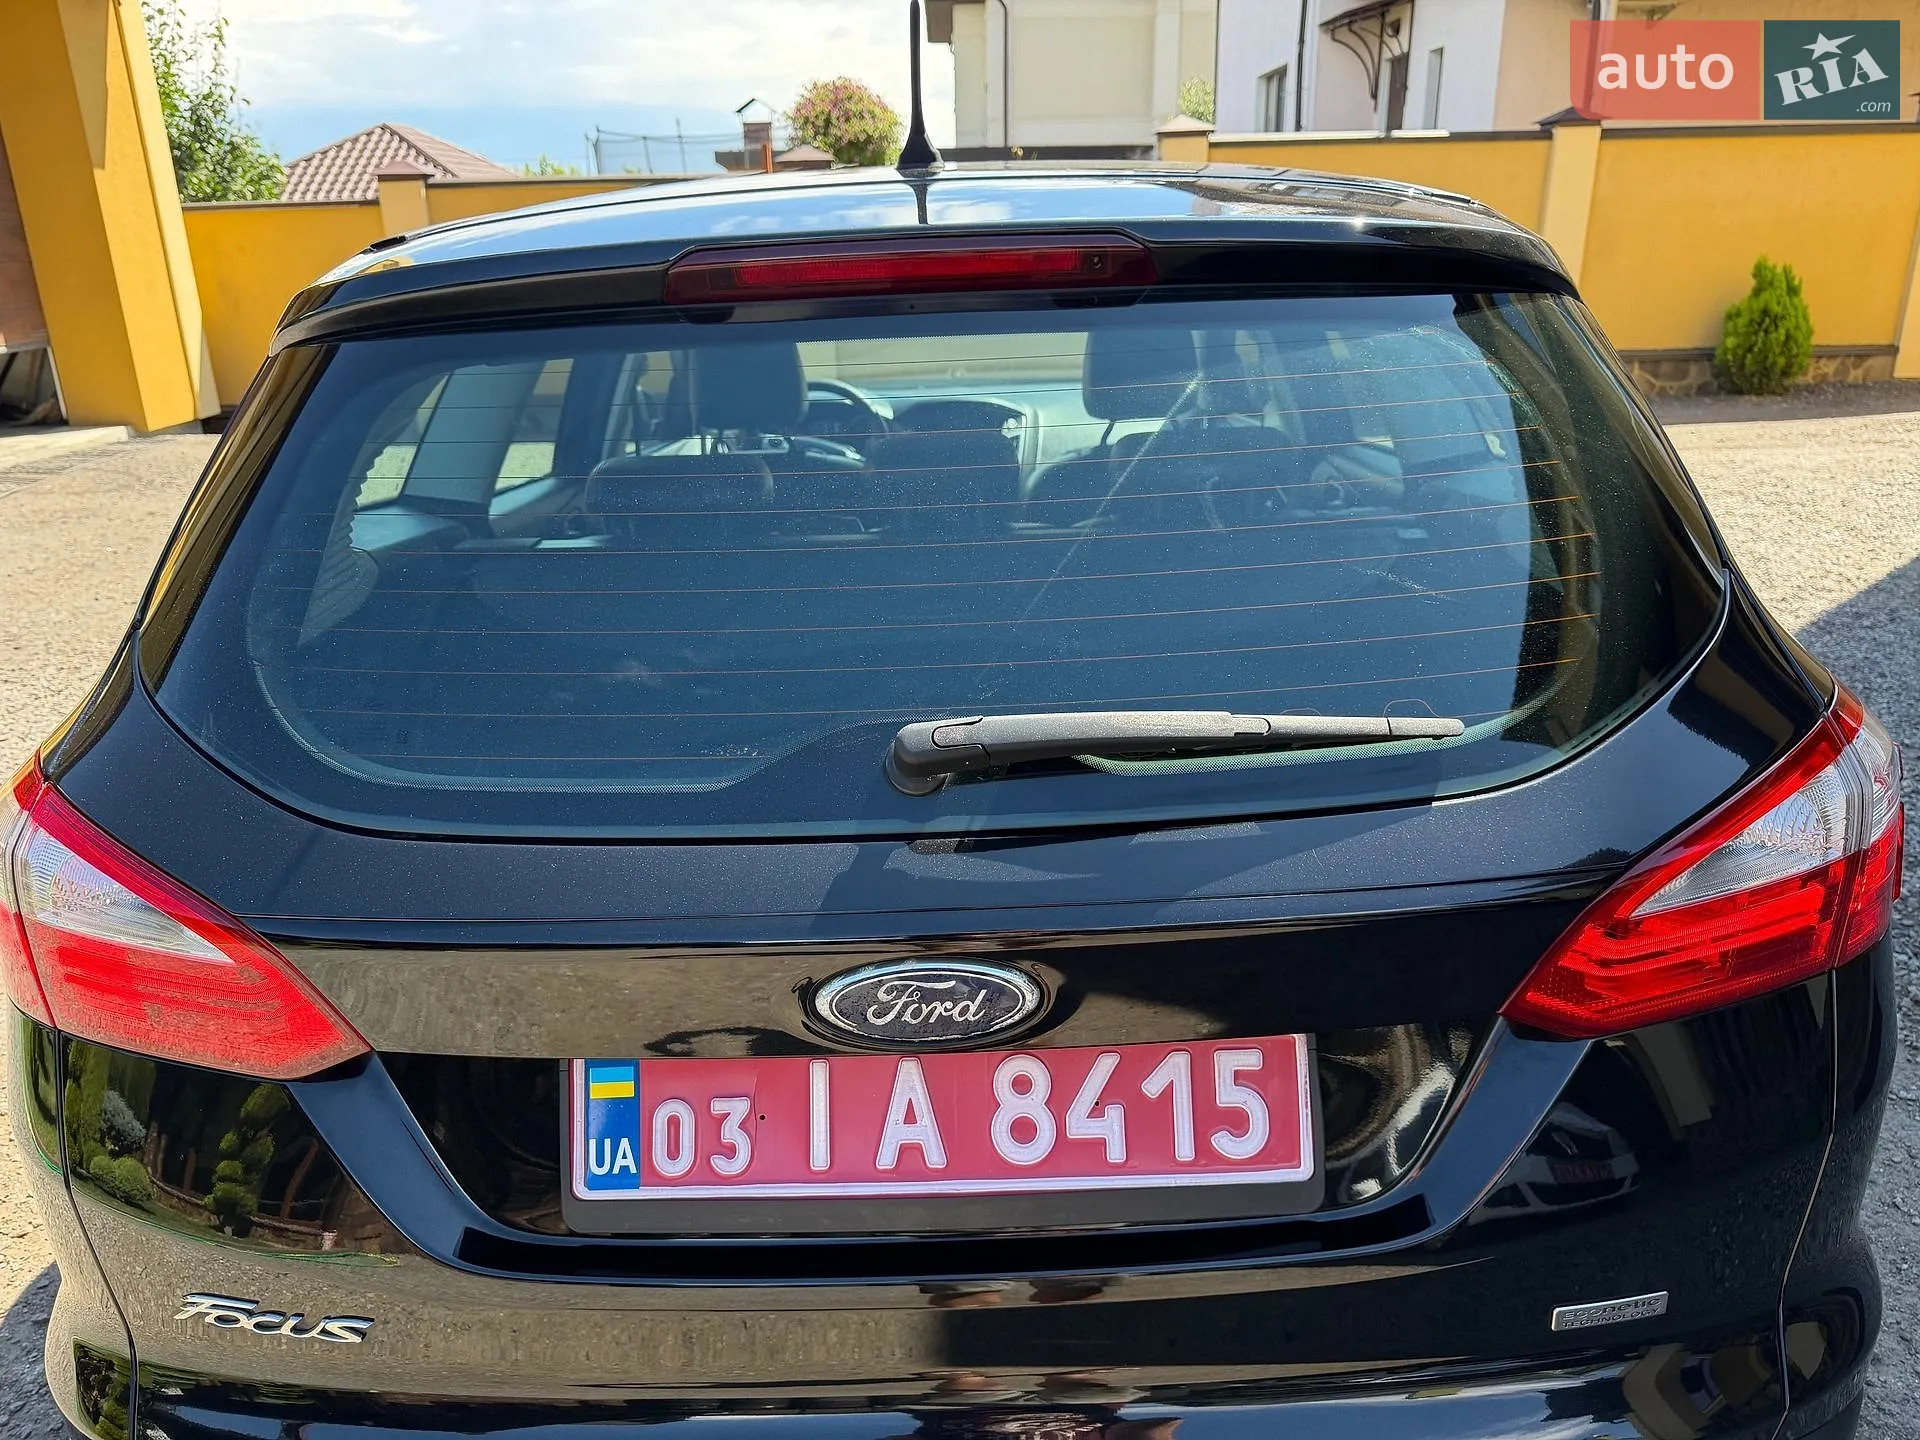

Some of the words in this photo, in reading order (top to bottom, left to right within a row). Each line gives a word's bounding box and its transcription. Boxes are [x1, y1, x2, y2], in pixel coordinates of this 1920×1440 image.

[866, 980, 988, 1026] Ford
[652, 1096, 752, 1177] 03
[991, 1048, 1270, 1166] 8415
[588, 1137, 638, 1176] UA
[1561, 1308, 1662, 1329] TECHNOLOGY
